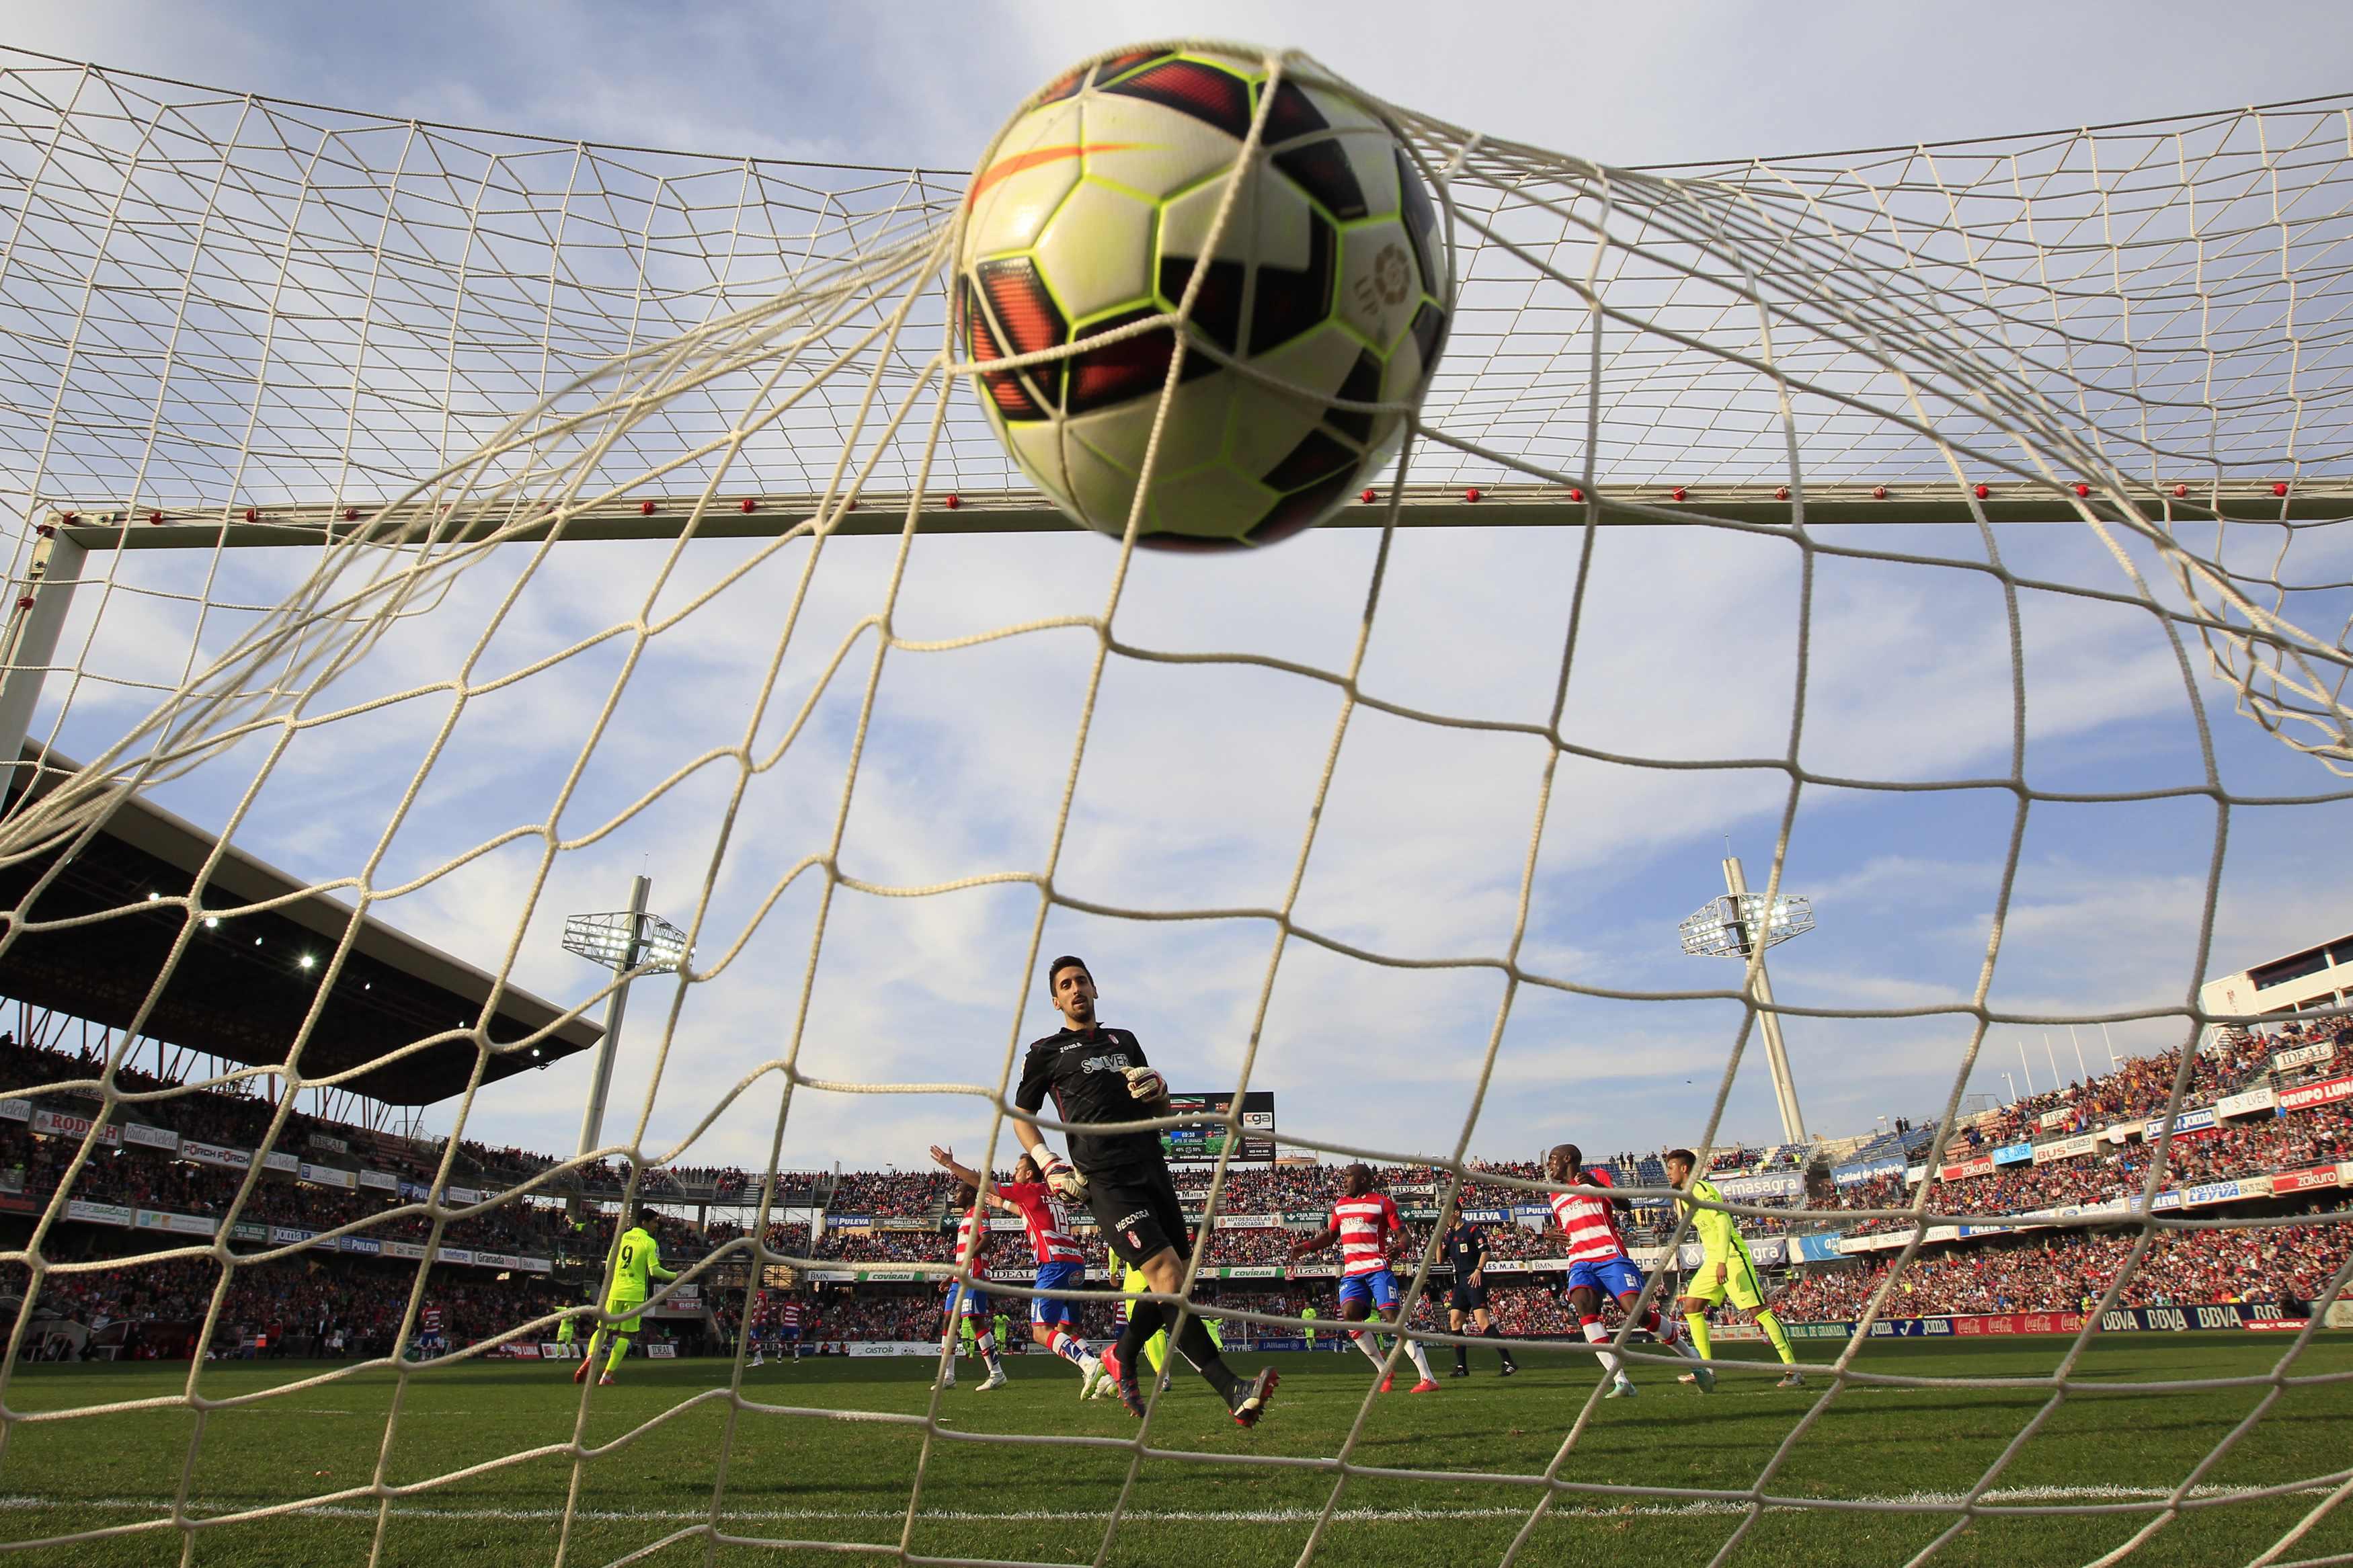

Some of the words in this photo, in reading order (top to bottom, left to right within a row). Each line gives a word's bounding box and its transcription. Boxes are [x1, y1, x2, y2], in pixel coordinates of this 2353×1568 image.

[2282, 1045, 2327, 1065] IDEAL
[2280, 1088, 2323, 1108] GRUPO
[2324, 1080, 2353, 1098] LUN
[1245, 1114, 1271, 1124] cga
[2046, 1110, 2072, 1123] IDEA
[2183, 1110, 2213, 1128] Joma
[2037, 1146, 2067, 1159] BUS
[1962, 1161, 1991, 1175] zakuro
[1837, 1171, 1861, 1183] Calidad
[1862, 1170, 1872, 1178] de
[2298, 1171, 2336, 1187] zakuro
[1723, 1178, 1797, 1196] emasagra
[2153, 1194, 2180, 1208] LEVA
[274, 1229, 301, 1241] Joma
[352, 1239, 379, 1253] PULEVA
[478, 1253, 504, 1264] Granada
[622, 1245, 633, 1270] 9
[1535, 1262, 1554, 1270] BMN
[2103, 1311, 2139, 1330] BBVA
[2147, 1309, 2188, 1329] BBVA
[2196, 1306, 2243, 1328] BBVA
[1818, 1325, 1847, 1336] GRANADA
[1923, 1319, 1949, 1335] Joma
